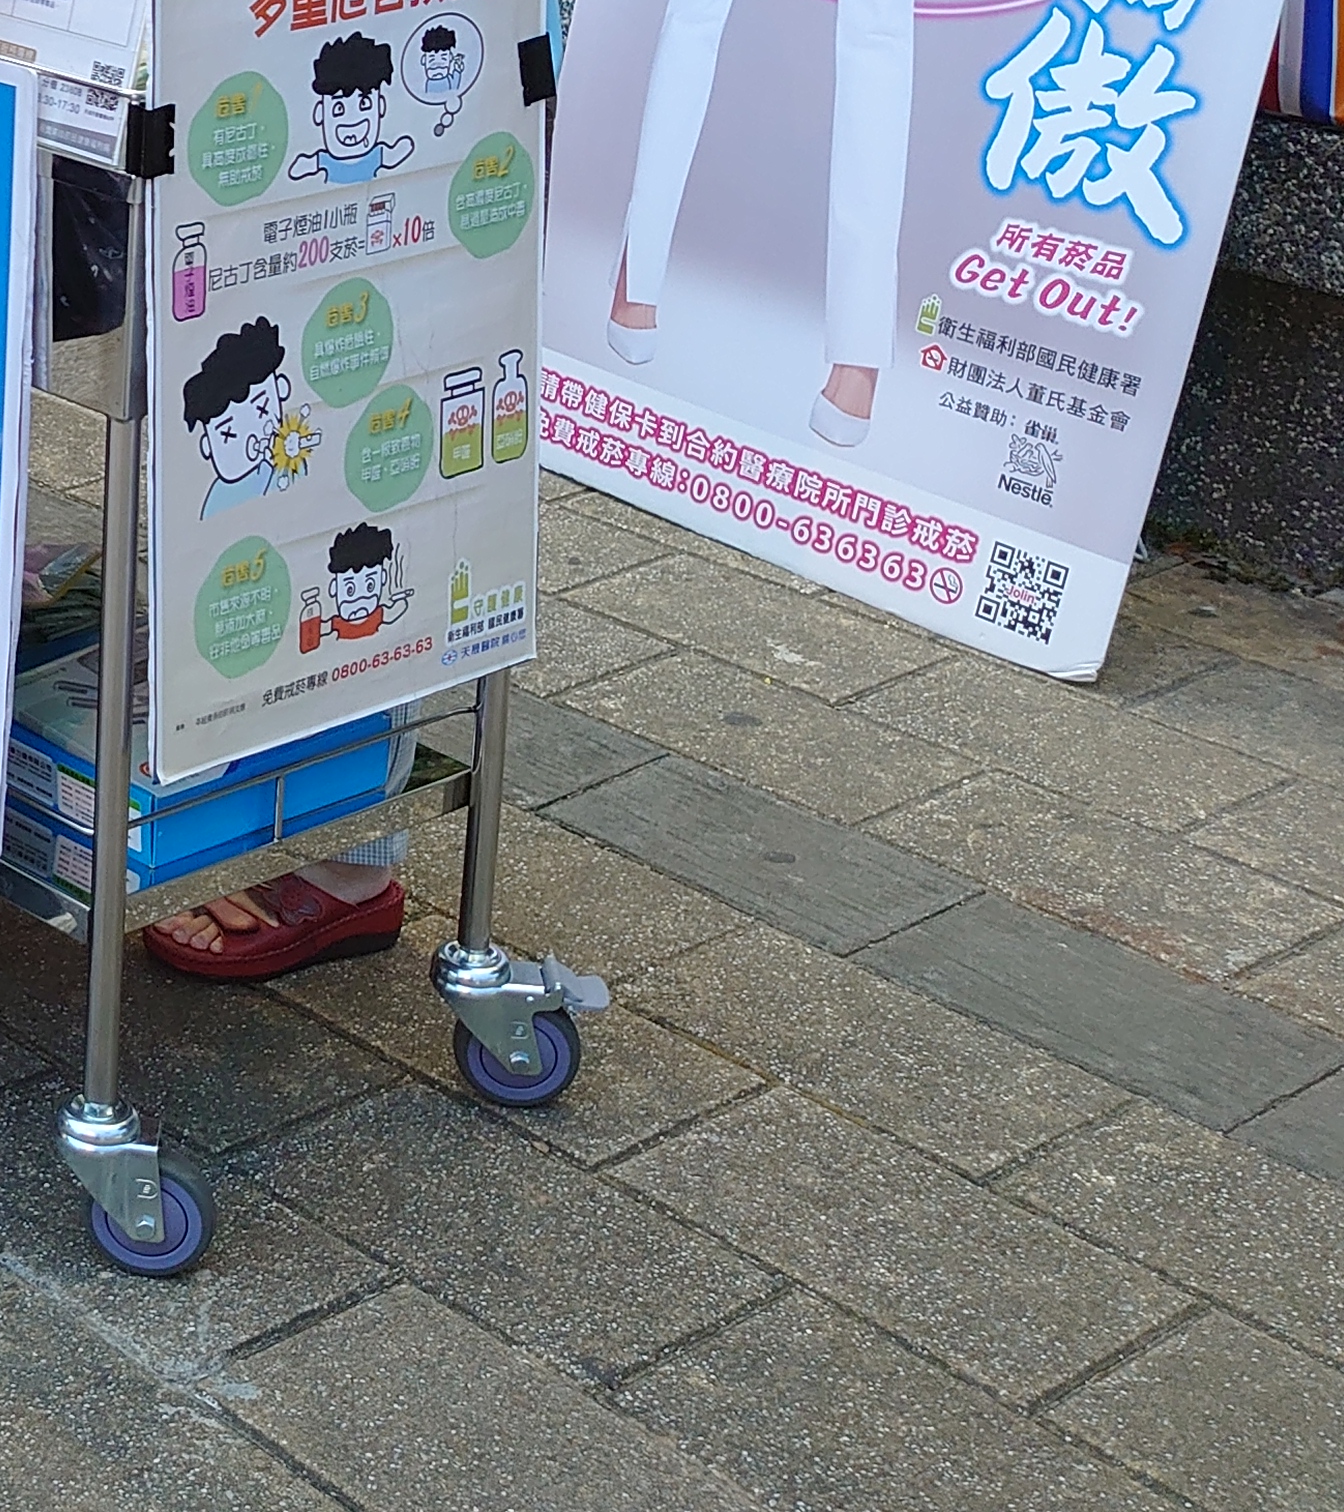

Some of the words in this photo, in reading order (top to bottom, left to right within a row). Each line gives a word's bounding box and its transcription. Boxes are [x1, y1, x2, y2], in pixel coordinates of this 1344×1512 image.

[996, 223, 1127, 280] 所有菸品
[955, 253, 1030, 299] Get
[1039, 278, 1138, 332] Out!
[937, 316, 1142, 397] 衛生福利部國民健康署
[947, 356, 1131, 433] 財團法人董氏基金會
[541, 371, 977, 561] 請帶健保卡到合約醫療院所門診戒菸
[1006, 586, 1038, 607] Jolin
[331, 636, 434, 682] 0800-63-63-63
